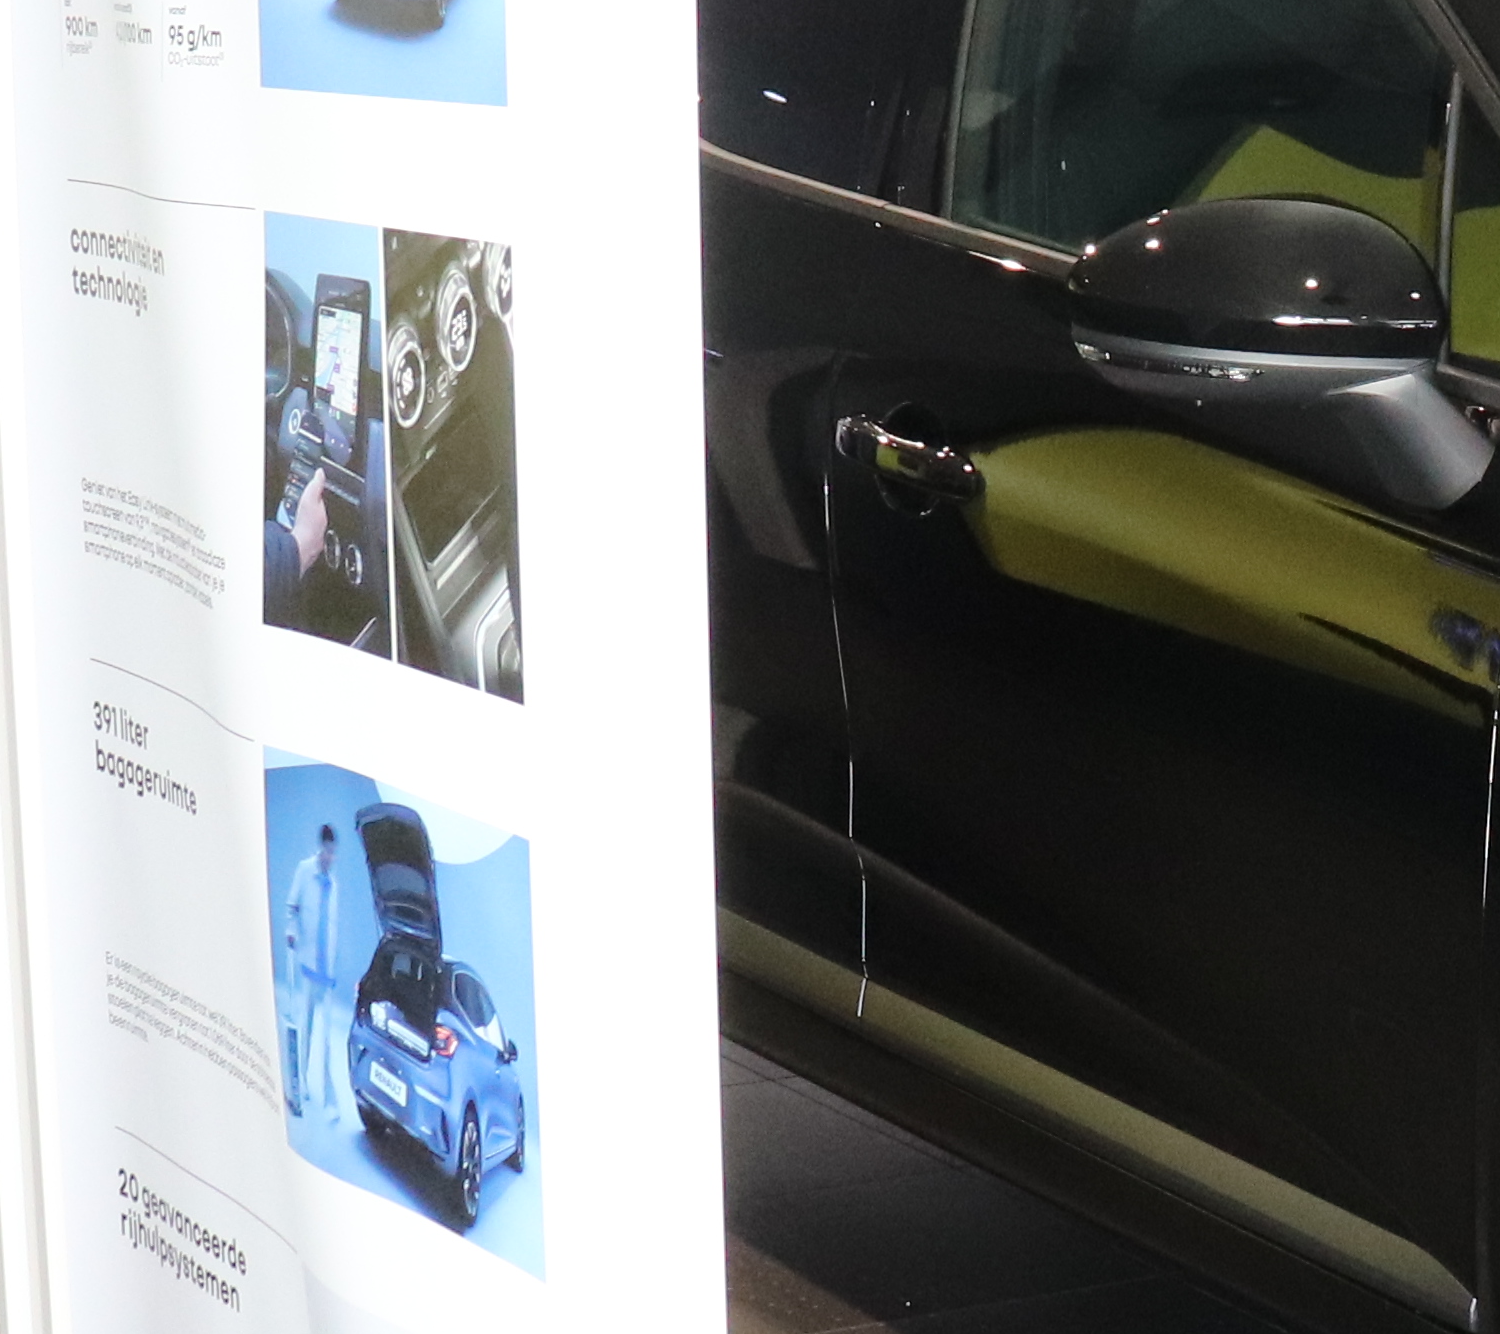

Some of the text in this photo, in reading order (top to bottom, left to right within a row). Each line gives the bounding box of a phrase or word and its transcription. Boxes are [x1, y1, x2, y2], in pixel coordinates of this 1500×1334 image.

[65, 16, 84, 37] 900
[136, 21, 153, 45] km
[168, 24, 223, 52] 95 g/km
[70, 228, 165, 276] connectiviteit en
[72, 265, 148, 317] technologie
[93, 701, 149, 750] 391 liter
[95, 739, 197, 816] bagageruimte
[118, 1168, 247, 1277] 20 geavanceerde
[121, 1208, 240, 1313] rijhulpsystemen
